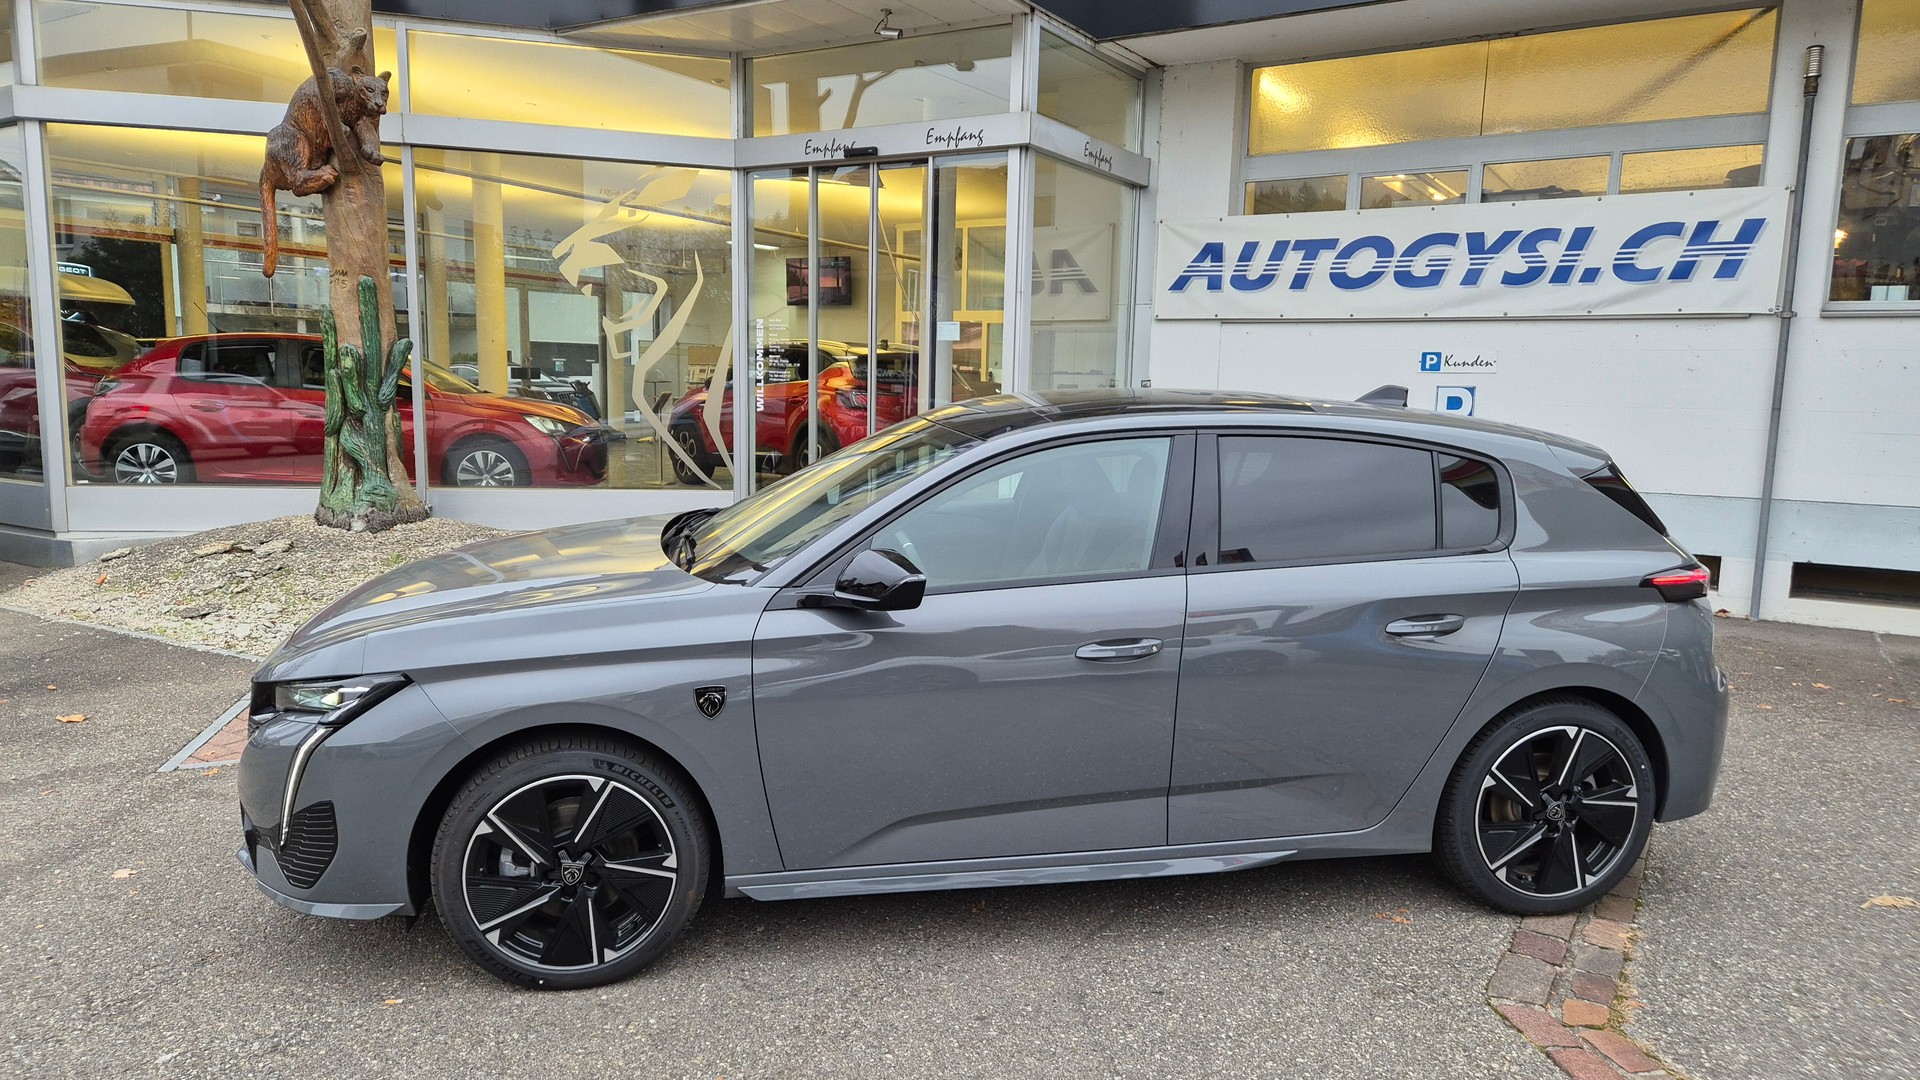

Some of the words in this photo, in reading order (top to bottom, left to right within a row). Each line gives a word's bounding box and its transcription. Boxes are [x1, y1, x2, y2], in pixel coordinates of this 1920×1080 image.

[925, 125, 984, 148] Empfang
[1083, 141, 1112, 171] Empfang
[1167, 217, 1767, 293] AUTOGYSI.CH
[756, 318, 765, 412] WILLKOMMEN
[1425, 354, 1438, 370] P
[1443, 353, 1494, 368] Kunden
[611, 764, 674, 807] MICHELIN
